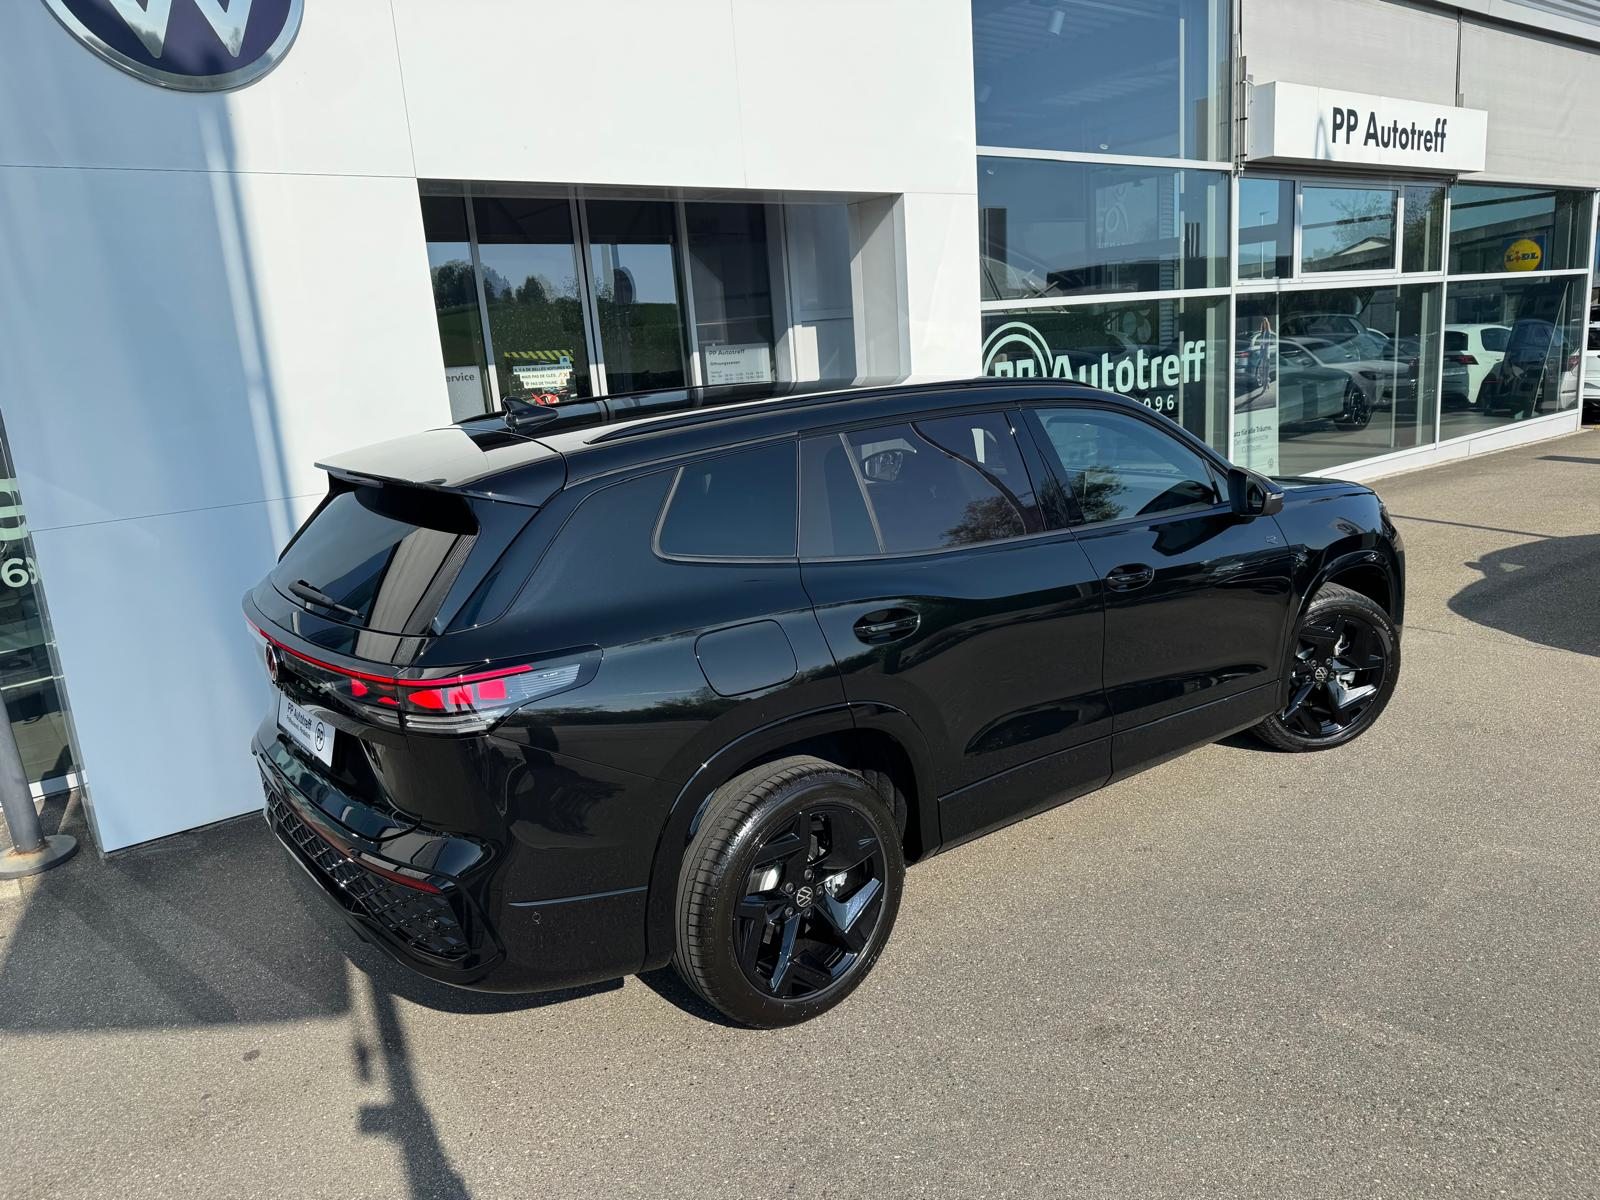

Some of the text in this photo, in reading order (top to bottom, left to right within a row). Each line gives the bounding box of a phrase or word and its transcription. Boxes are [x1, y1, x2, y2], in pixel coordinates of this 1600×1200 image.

[1331, 106, 1448, 153] PP Autotreff
[446, 372, 475, 383] ervice
[1052, 340, 1206, 393] Autotreff
